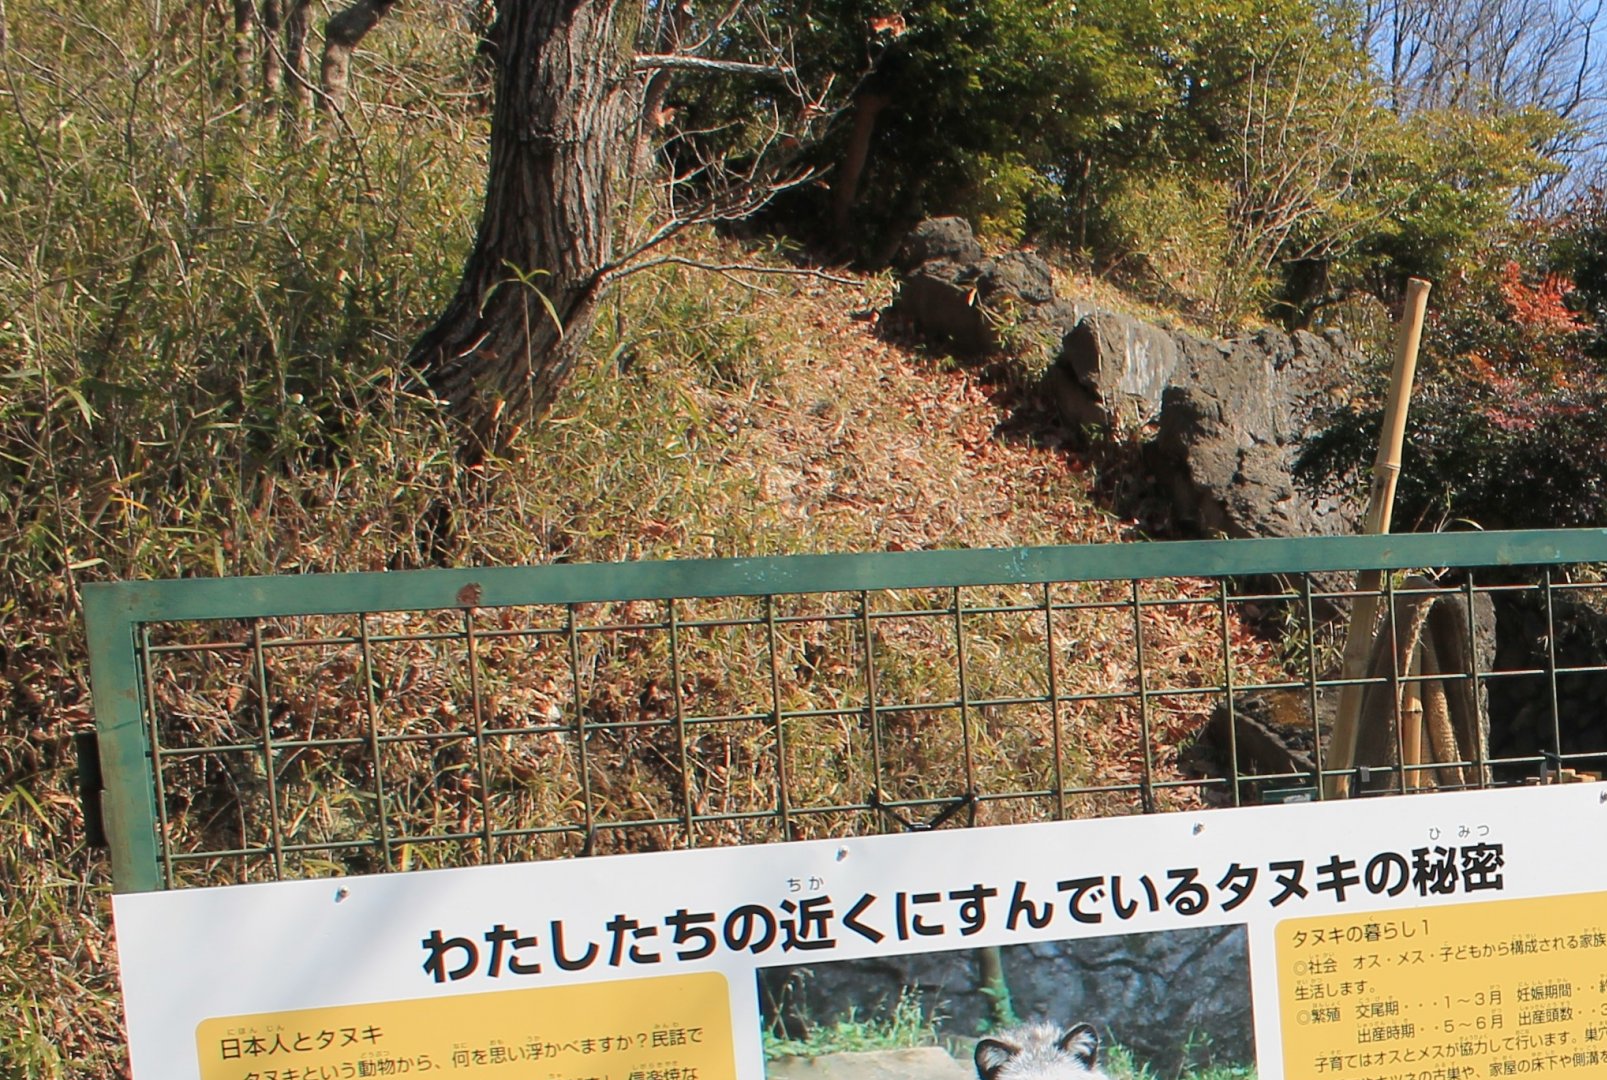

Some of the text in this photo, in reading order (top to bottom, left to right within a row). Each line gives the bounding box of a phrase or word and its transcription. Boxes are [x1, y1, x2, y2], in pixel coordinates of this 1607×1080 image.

[785, 874, 825, 894] ちか
[420, 840, 1507, 985] わたしたちの近くにすんでいるタヌキの秘密
[1291, 918, 1430, 950] タヌキの暮らし1
[1293, 978, 1376, 1002] 生活します。
[219, 1023, 385, 1062] 日本人とタヌキ
